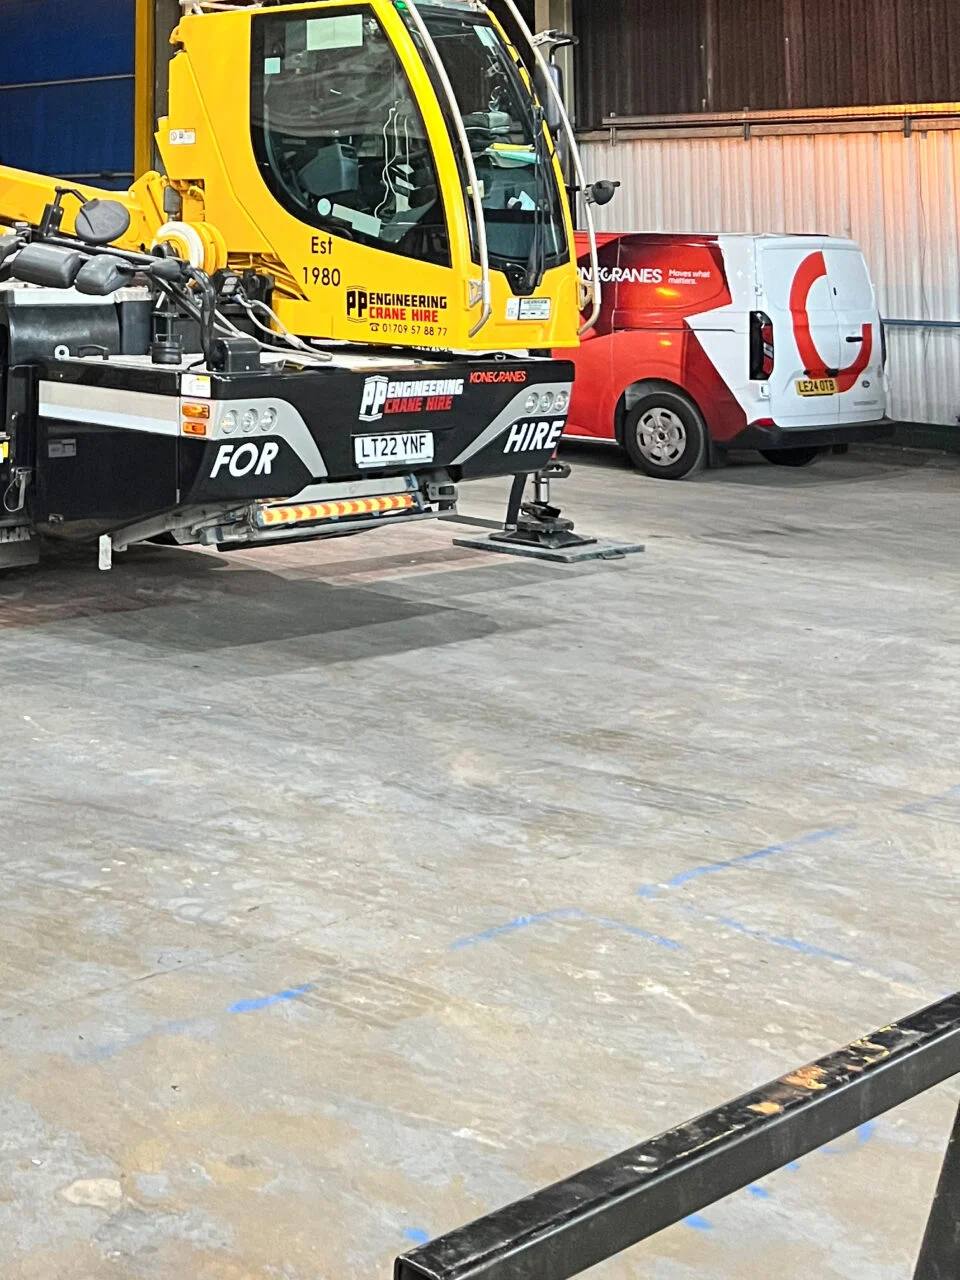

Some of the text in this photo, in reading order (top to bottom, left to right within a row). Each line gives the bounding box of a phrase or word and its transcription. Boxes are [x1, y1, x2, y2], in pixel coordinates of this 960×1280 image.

[311, 236, 333, 254] Est
[302, 266, 341, 287] 1980
[668, 269, 692, 277] Moves
[693, 270, 711, 278] what
[346, 290, 447, 318] PP ENGINEERING
[369, 307, 438, 323] CRANE HIRE
[382, 323, 448, 336] 01709 57 88 77
[469, 370, 527, 384] KONECRANES
[797, 380, 819, 393] LE24
[360, 379, 465, 415] PP ENGINEERING
[384, 396, 454, 414] CRANE HIRE
[503, 420, 565, 454] HIRE
[362, 435, 427, 458] LT22 YNF
[209, 441, 280, 479] FOR
